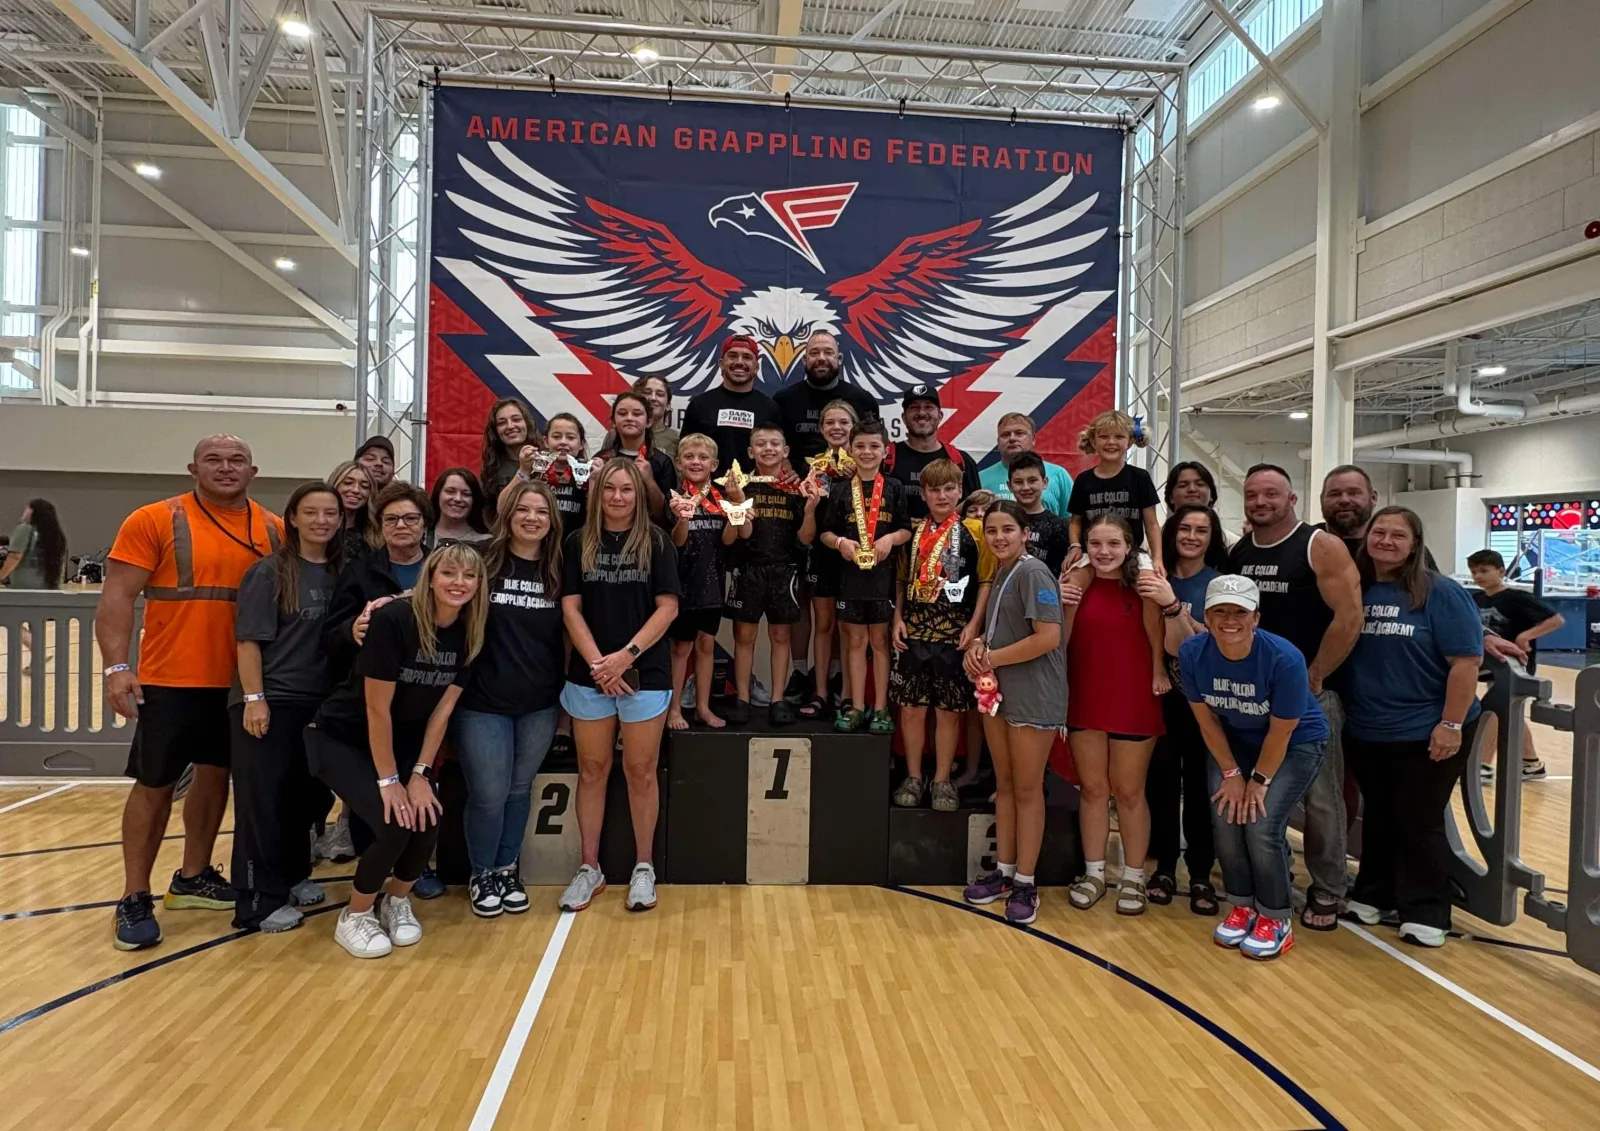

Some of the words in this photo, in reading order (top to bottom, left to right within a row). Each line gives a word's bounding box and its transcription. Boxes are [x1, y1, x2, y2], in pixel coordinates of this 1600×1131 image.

[466, 115, 656, 148] AMERICAN
[674, 127, 871, 161] GRAPPLING
[887, 139, 1093, 176] FEDERATION
[729, 410, 752, 418] DAISY
[852, 486, 867, 533] FEDERATION
[1255, 565, 1278, 576] COLLAR
[504, 579, 520, 591] BLUE
[520, 580, 545, 594] COLLAR
[1258, 582, 1289, 593] ACADEMY
[490, 592, 526, 608] GRAPPLING
[1371, 604, 1400, 618] COLLAR
[1376, 621, 1415, 637] ACADEMY
[1213, 678, 1230, 692] BLUE
[1239, 700, 1271, 716] ACADEMY
[764, 749, 792, 800] 1
[535, 783, 571, 835] 2
